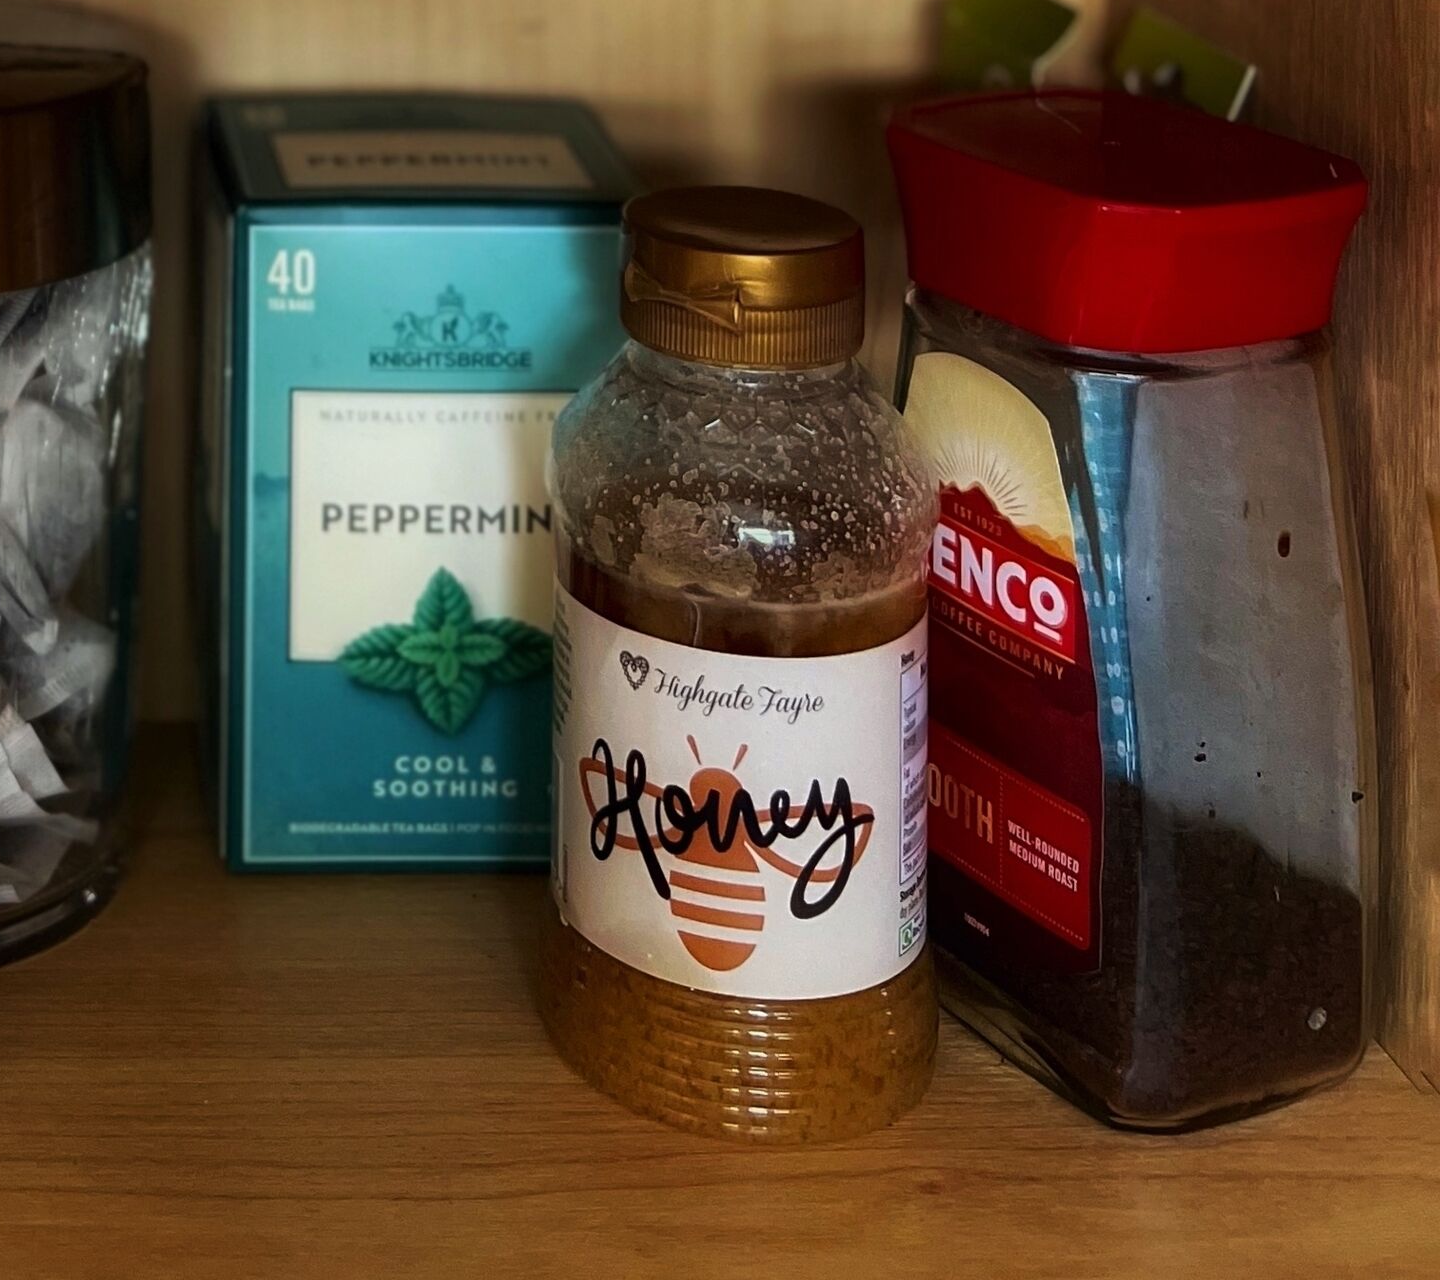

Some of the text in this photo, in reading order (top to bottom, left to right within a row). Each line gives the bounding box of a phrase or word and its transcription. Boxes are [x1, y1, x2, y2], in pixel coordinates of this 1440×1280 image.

[267, 249, 315, 295] 40
[370, 351, 533, 368] KNIGHTSBRIDGE
[319, 409, 556, 424] NATURALLY CAFFEINE FR
[322, 503, 552, 534] PEPPERMIN
[953, 503, 1002, 536] EST 1923
[931, 522, 1068, 636] ENCO
[933, 597, 1064, 680] COFFEE COMPANY
[654, 668, 825, 724] Highgate Fayre
[395, 756, 496, 774] COOL &
[373, 779, 518, 798] SOOTHING
[928, 763, 993, 844] OOTH
[289, 821, 389, 834] BIODEGRADABLE
[392, 821, 414, 833] TEA
[417, 821, 448, 833] BAGS
[590, 738, 874, 919] Honey
[1008, 819, 1080, 874] WELL-ROUNDED
[1009, 840, 1078, 892] MEDIUM ROAST
